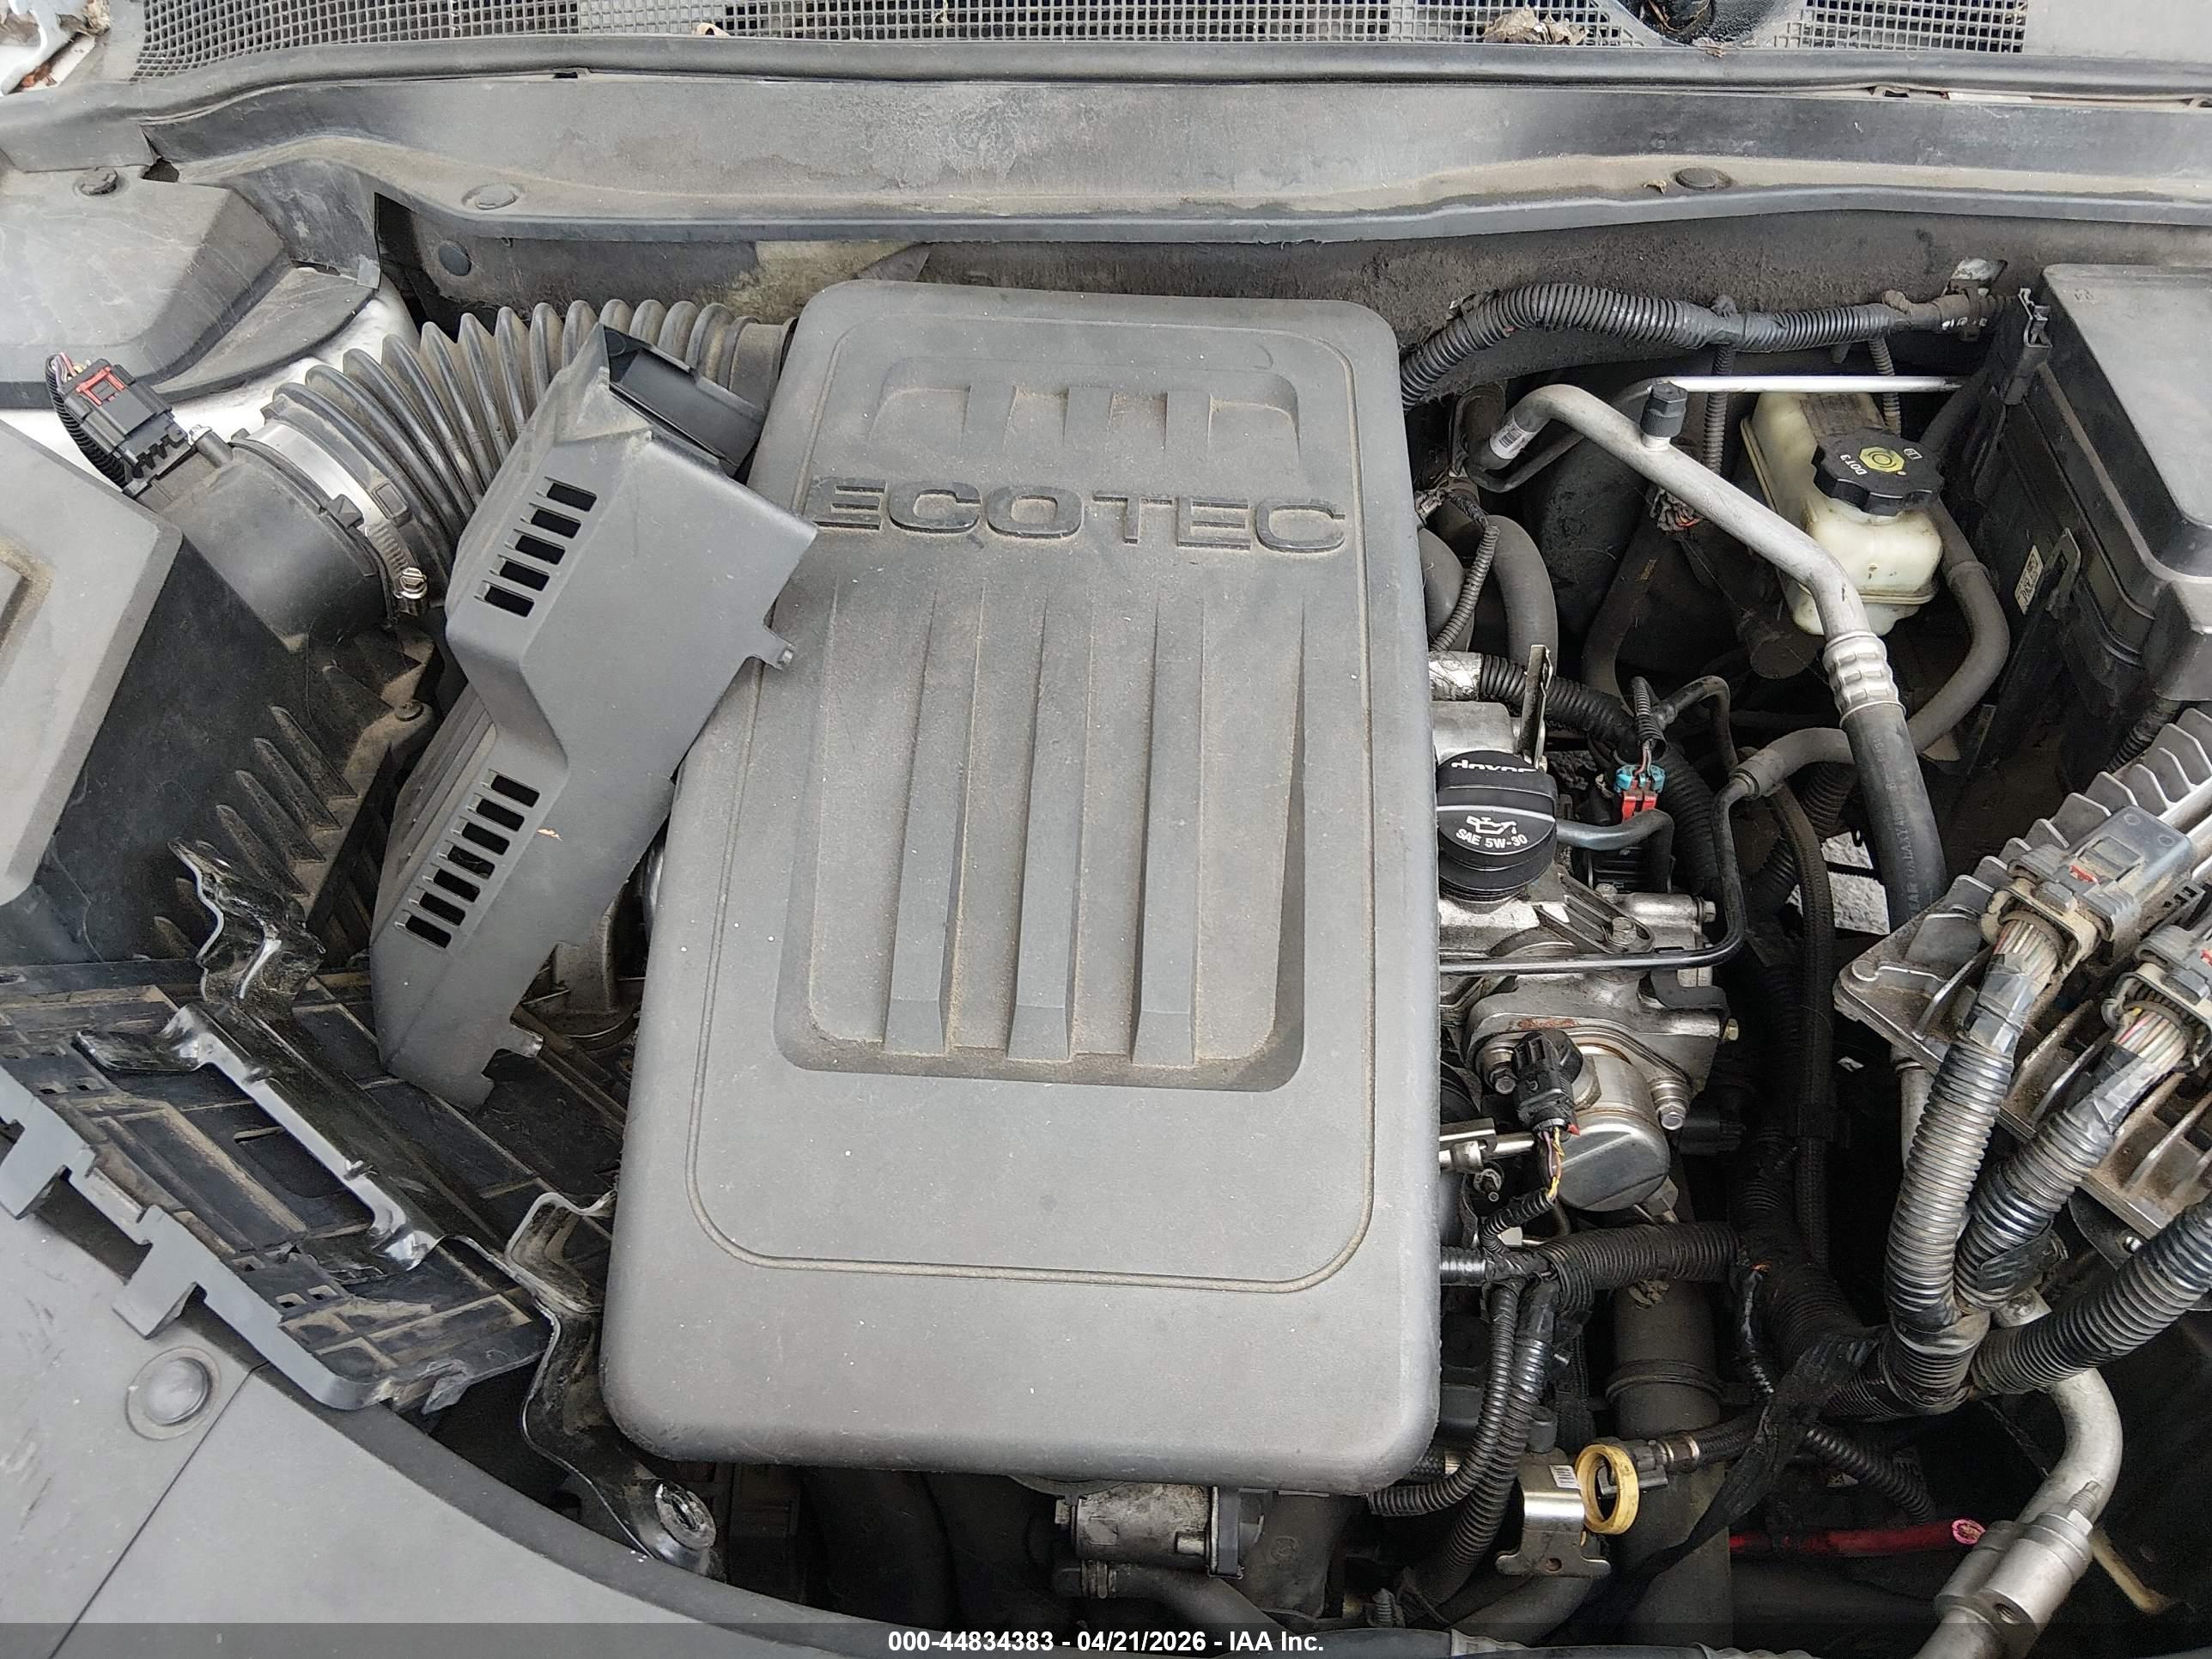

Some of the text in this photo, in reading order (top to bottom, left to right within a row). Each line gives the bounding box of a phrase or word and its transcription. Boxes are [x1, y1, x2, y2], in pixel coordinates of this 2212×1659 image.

[1839, 453, 1868, 476] DOT 3
[812, 477, 1347, 553] ECOTEC
[1455, 828, 1528, 848] SAE 5W-30
